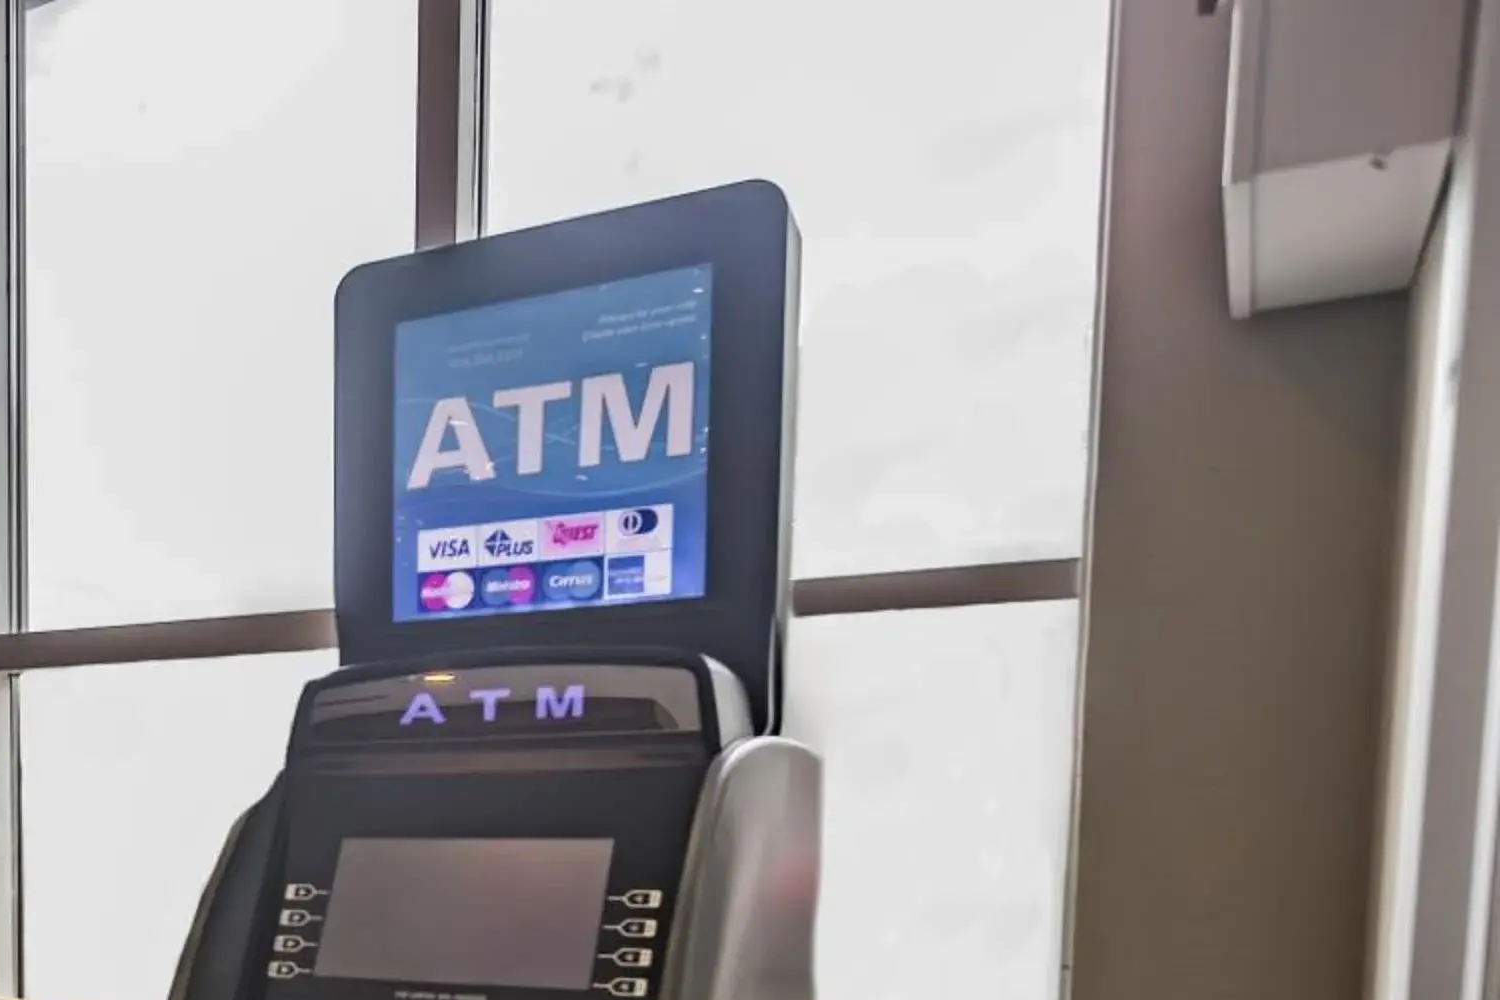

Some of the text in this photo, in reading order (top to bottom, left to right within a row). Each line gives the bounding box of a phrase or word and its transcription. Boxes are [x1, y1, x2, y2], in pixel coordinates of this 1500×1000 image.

[407, 362, 695, 490] ATM
[429, 539, 471, 558] VISA
[496, 540, 534, 557] PLUS
[400, 684, 585, 725] ATM
